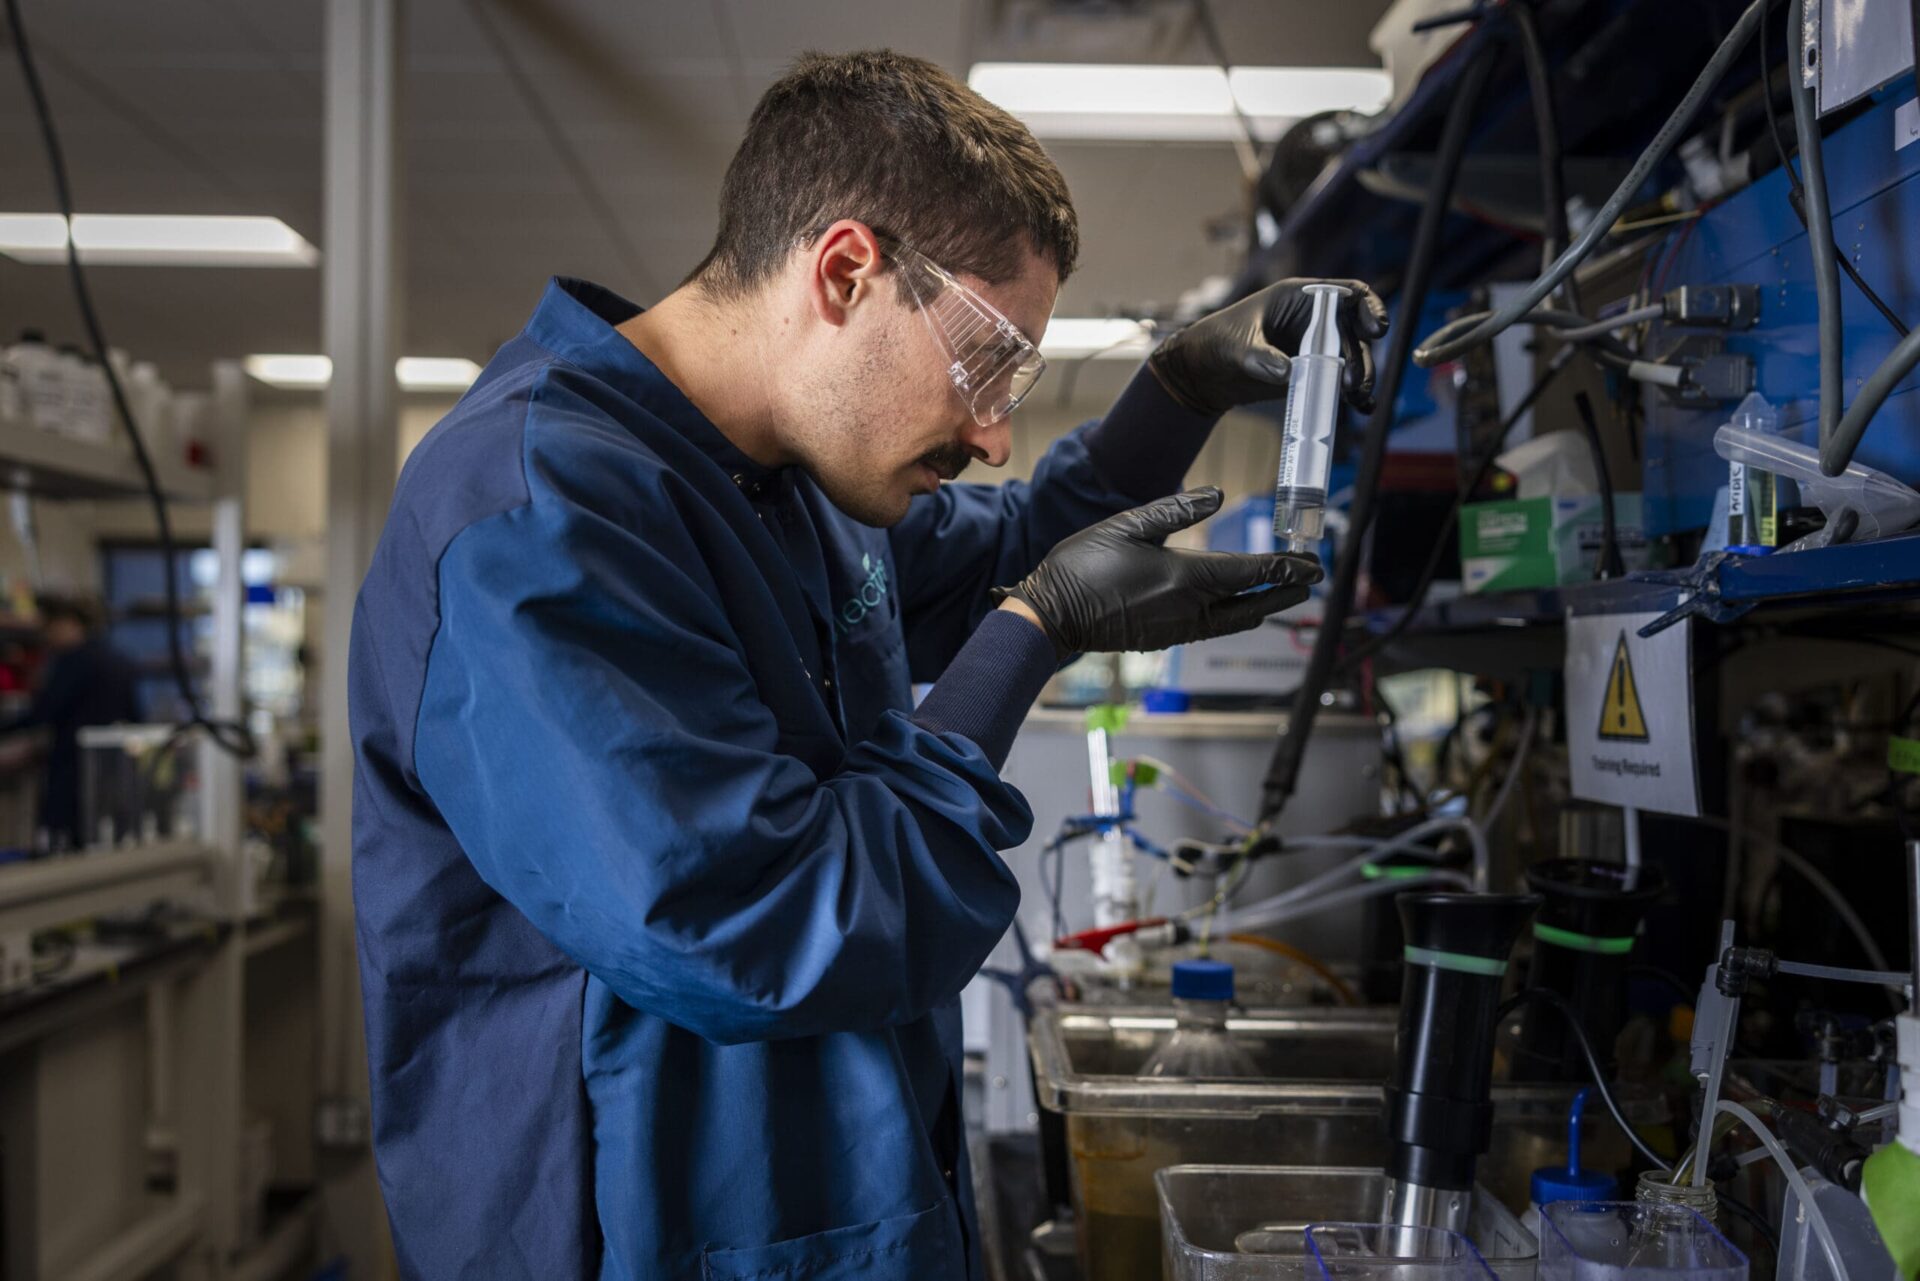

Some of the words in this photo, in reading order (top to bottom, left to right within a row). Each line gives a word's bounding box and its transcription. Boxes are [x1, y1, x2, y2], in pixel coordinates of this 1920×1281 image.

[1291, 418, 1299, 435] USE
[1288, 441, 1296, 463] AFTE
[1592, 755, 1621, 775] Training
[1622, 758, 1660, 777] Required
